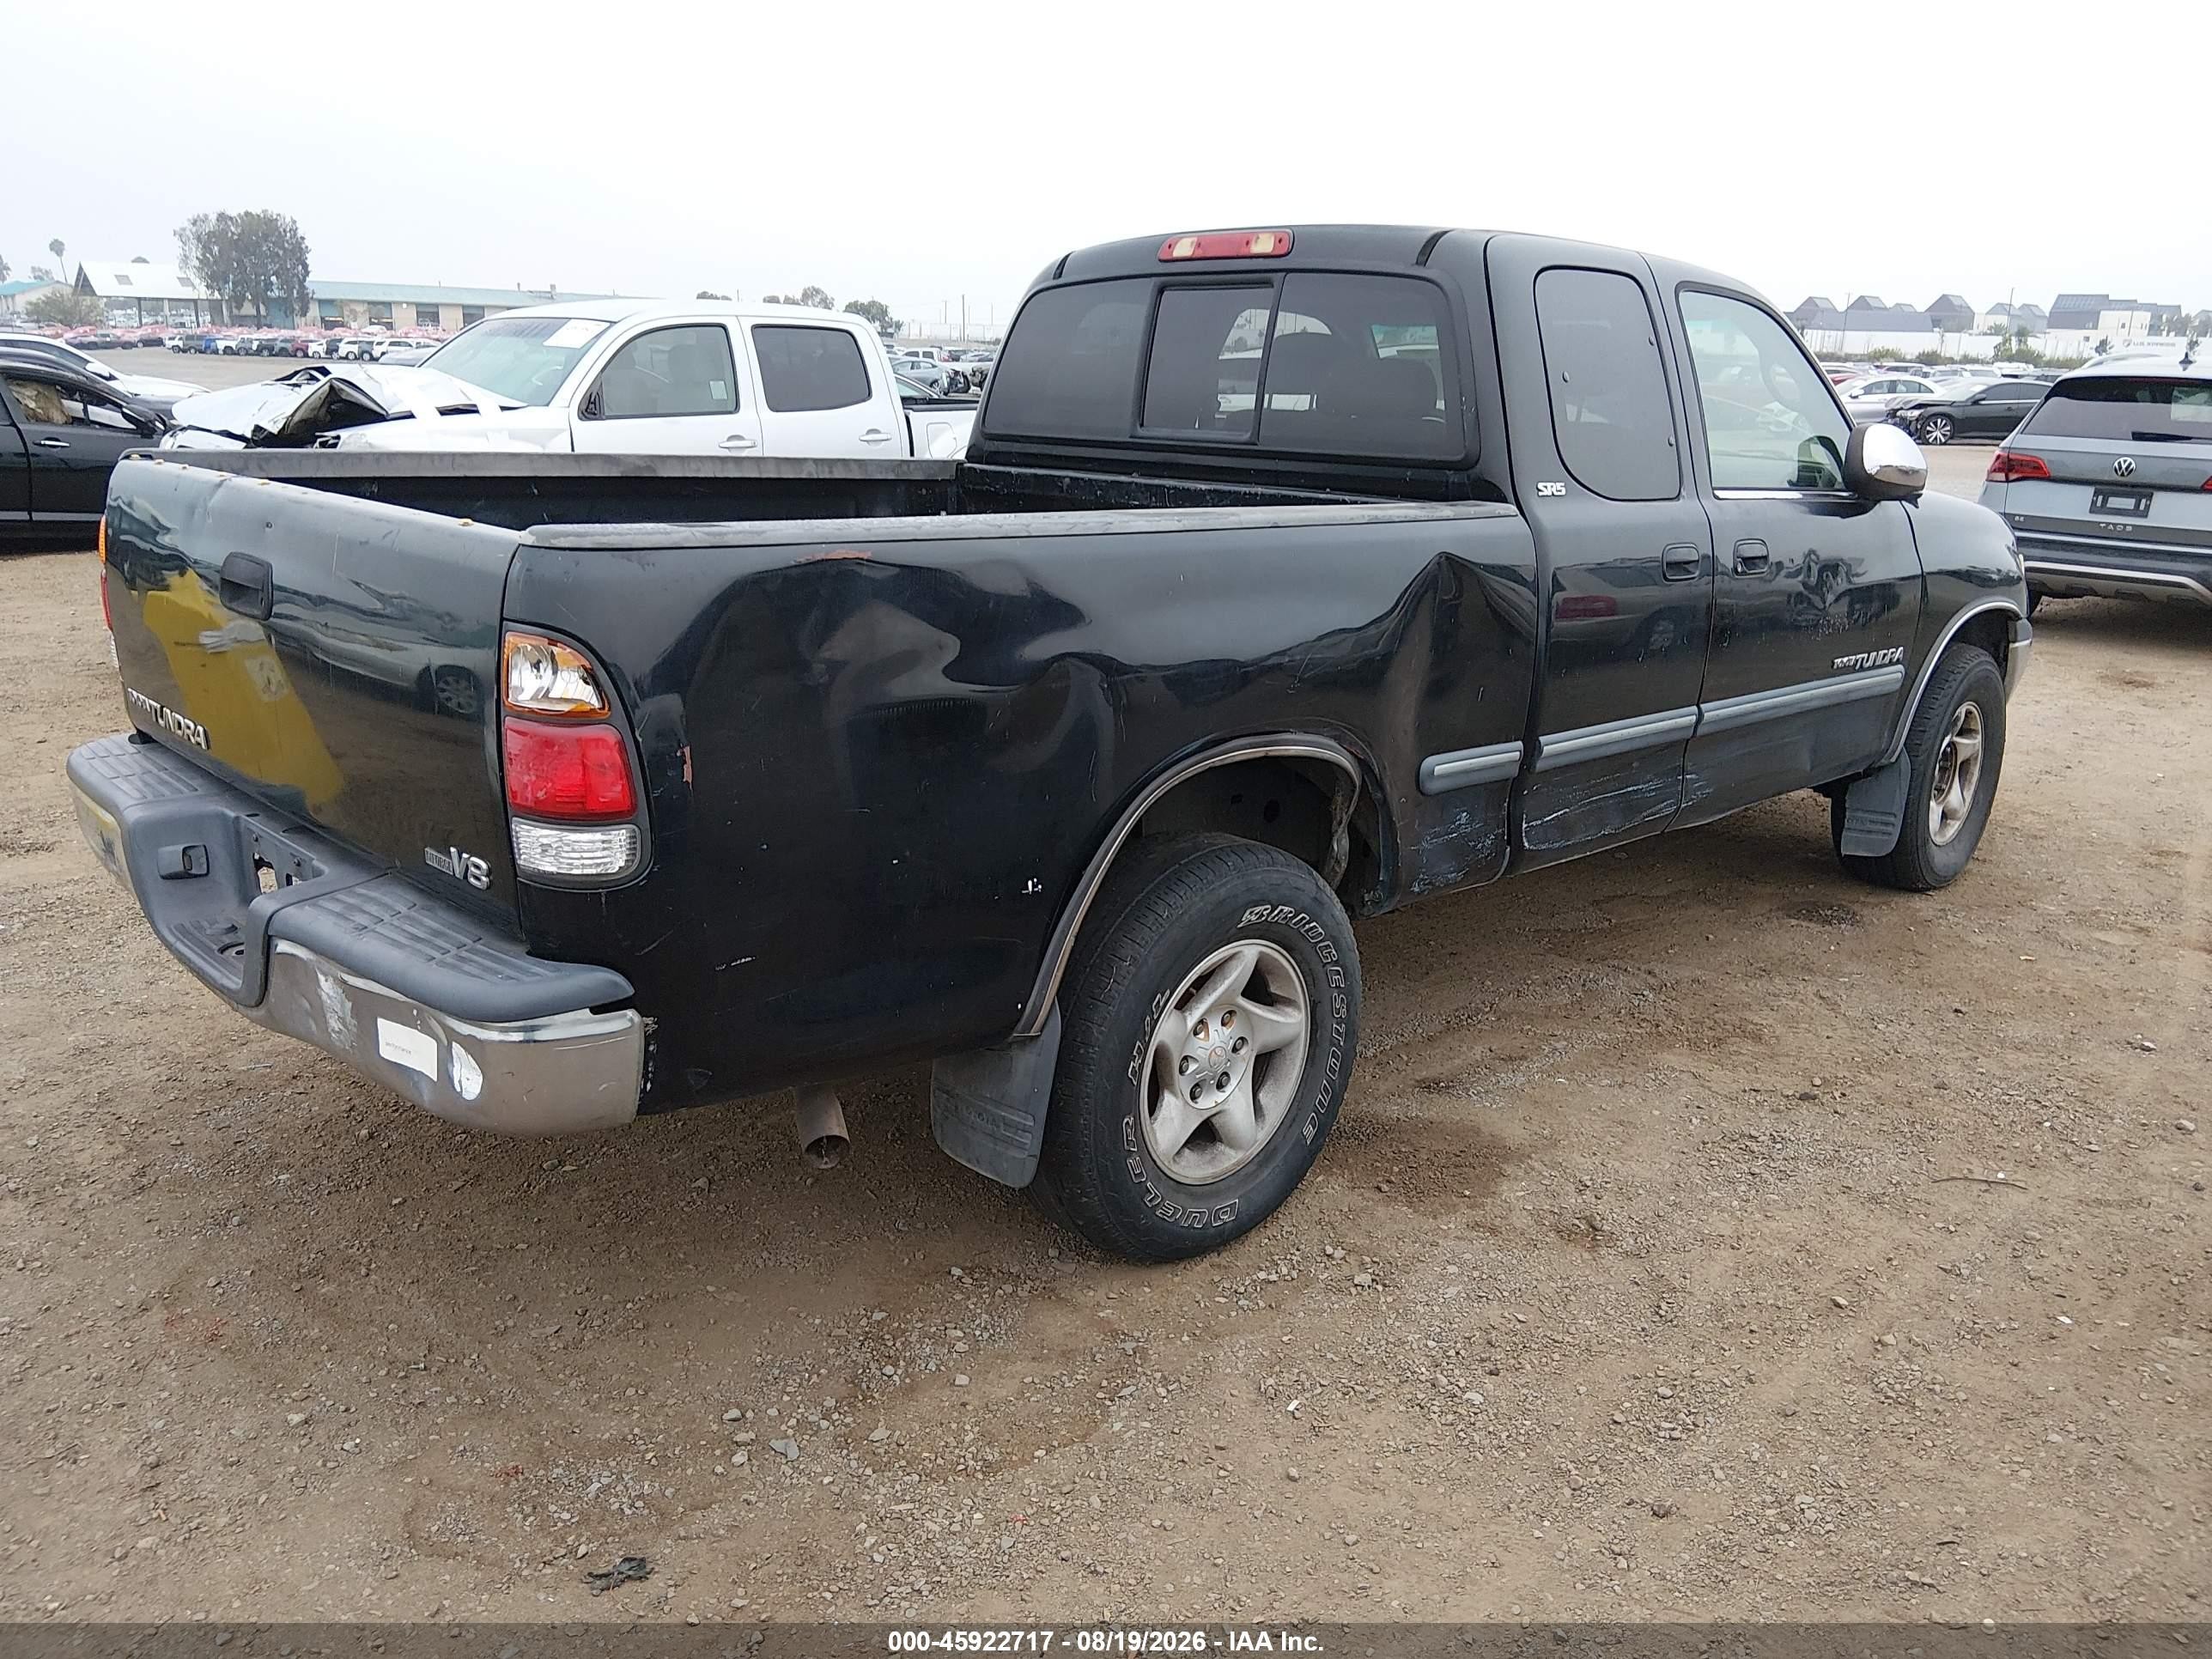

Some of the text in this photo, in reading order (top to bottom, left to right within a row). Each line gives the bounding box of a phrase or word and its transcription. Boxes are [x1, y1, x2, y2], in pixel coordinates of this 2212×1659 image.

[1537, 482, 1566, 496] SR5
[2099, 523, 2133, 532] TAOS
[1854, 646, 1904, 671] TUNDRA
[150, 699, 210, 750] TUNDRA
[449, 846, 492, 891] V8
[1236, 903, 1347, 1146] BRIDGESTONE
[1121, 1115, 1239, 1229] DUELER
